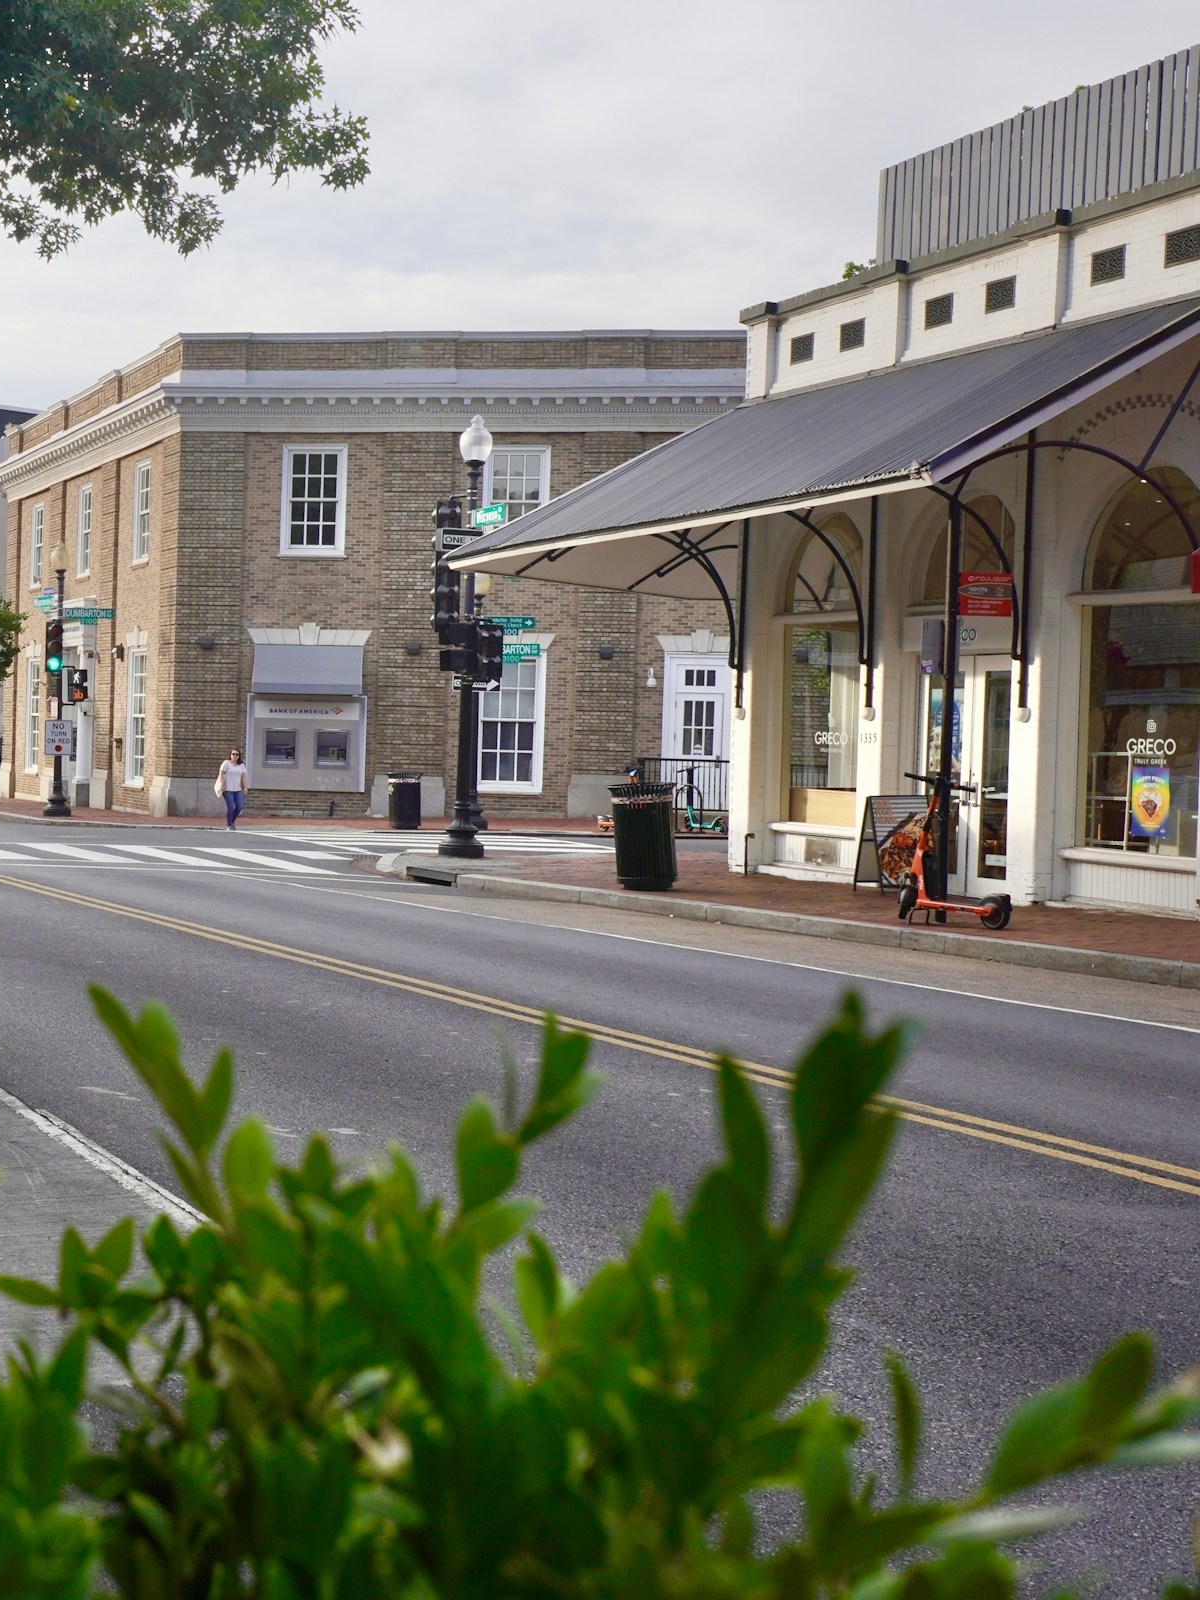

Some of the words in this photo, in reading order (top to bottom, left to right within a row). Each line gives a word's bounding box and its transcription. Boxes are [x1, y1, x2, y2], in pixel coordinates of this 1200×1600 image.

[445, 535, 466, 543] ONE
[66, 608, 106, 618] DUMBARTON
[502, 645, 531, 654] BARTON
[814, 731, 848, 745] GRECO
[860, 732, 878, 744] 1335
[1126, 738, 1177, 755] GRECO
[1136, 775, 1152, 785] HAPPY
